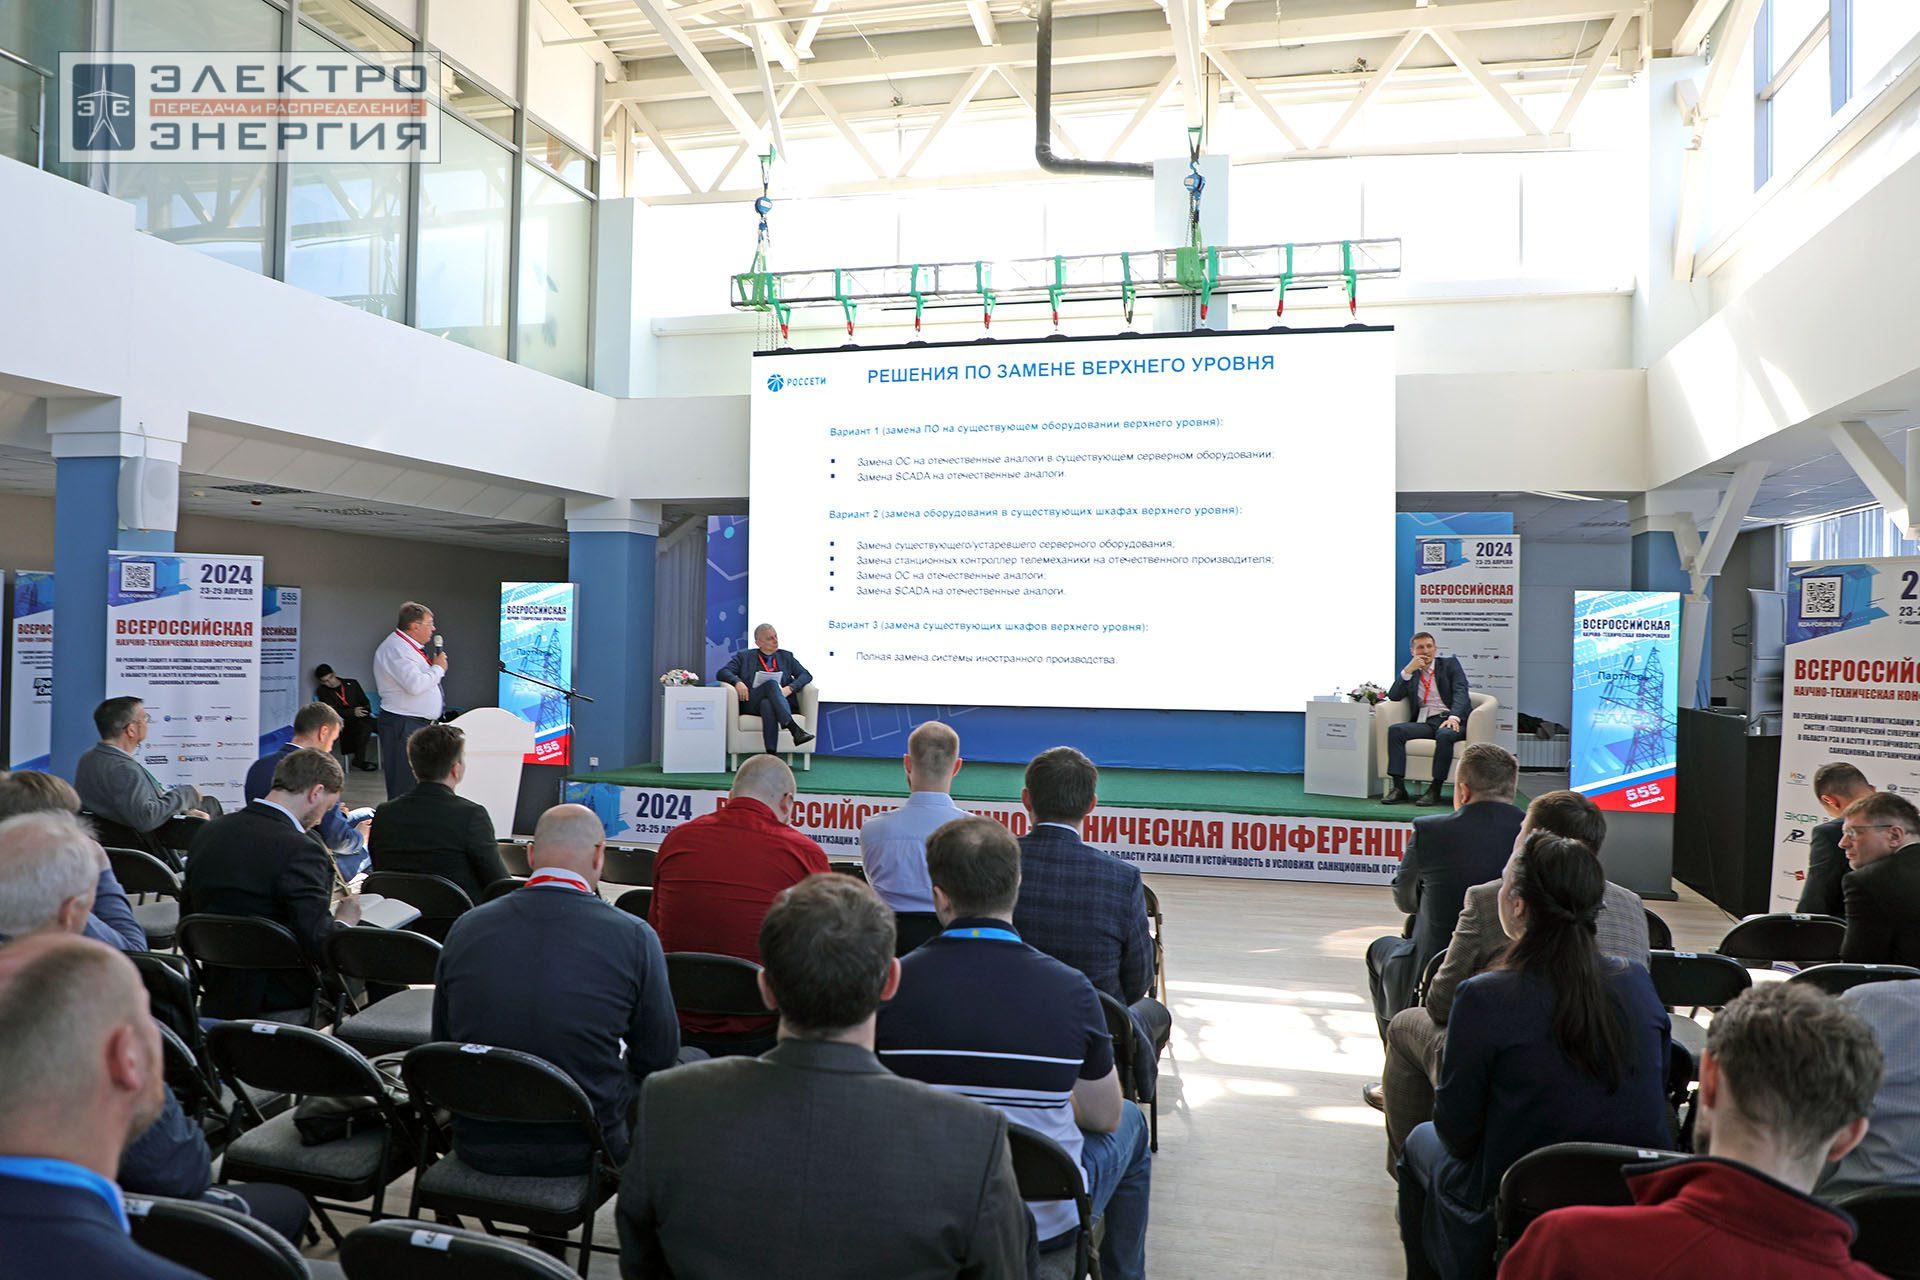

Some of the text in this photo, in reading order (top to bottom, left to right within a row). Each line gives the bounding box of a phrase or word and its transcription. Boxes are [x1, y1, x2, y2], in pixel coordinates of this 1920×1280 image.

[868, 355, 1275, 384] РЕШЕНИЯ ПО ЗАМЕНЕ ВЕРХНЕГО УРОВНЯ
[786, 376, 827, 387] РОССЕТИ
[1476, 542, 1513, 557] 2024
[200, 563, 253, 584] 2024
[1420, 583, 1513, 596] ВСЕРОССИЙСКАЯ
[115, 617, 253, 636] ВСЕРОССИЙСКАЯ
[1582, 617, 1671, 631] ВСЕРОССИЙСКАЯ
[1625, 783, 1661, 801] 555
[636, 792, 692, 820] 2024
[635, 824, 659, 833] 23-25
[1272, 859, 1315, 870] УСЛОВИЯХ
